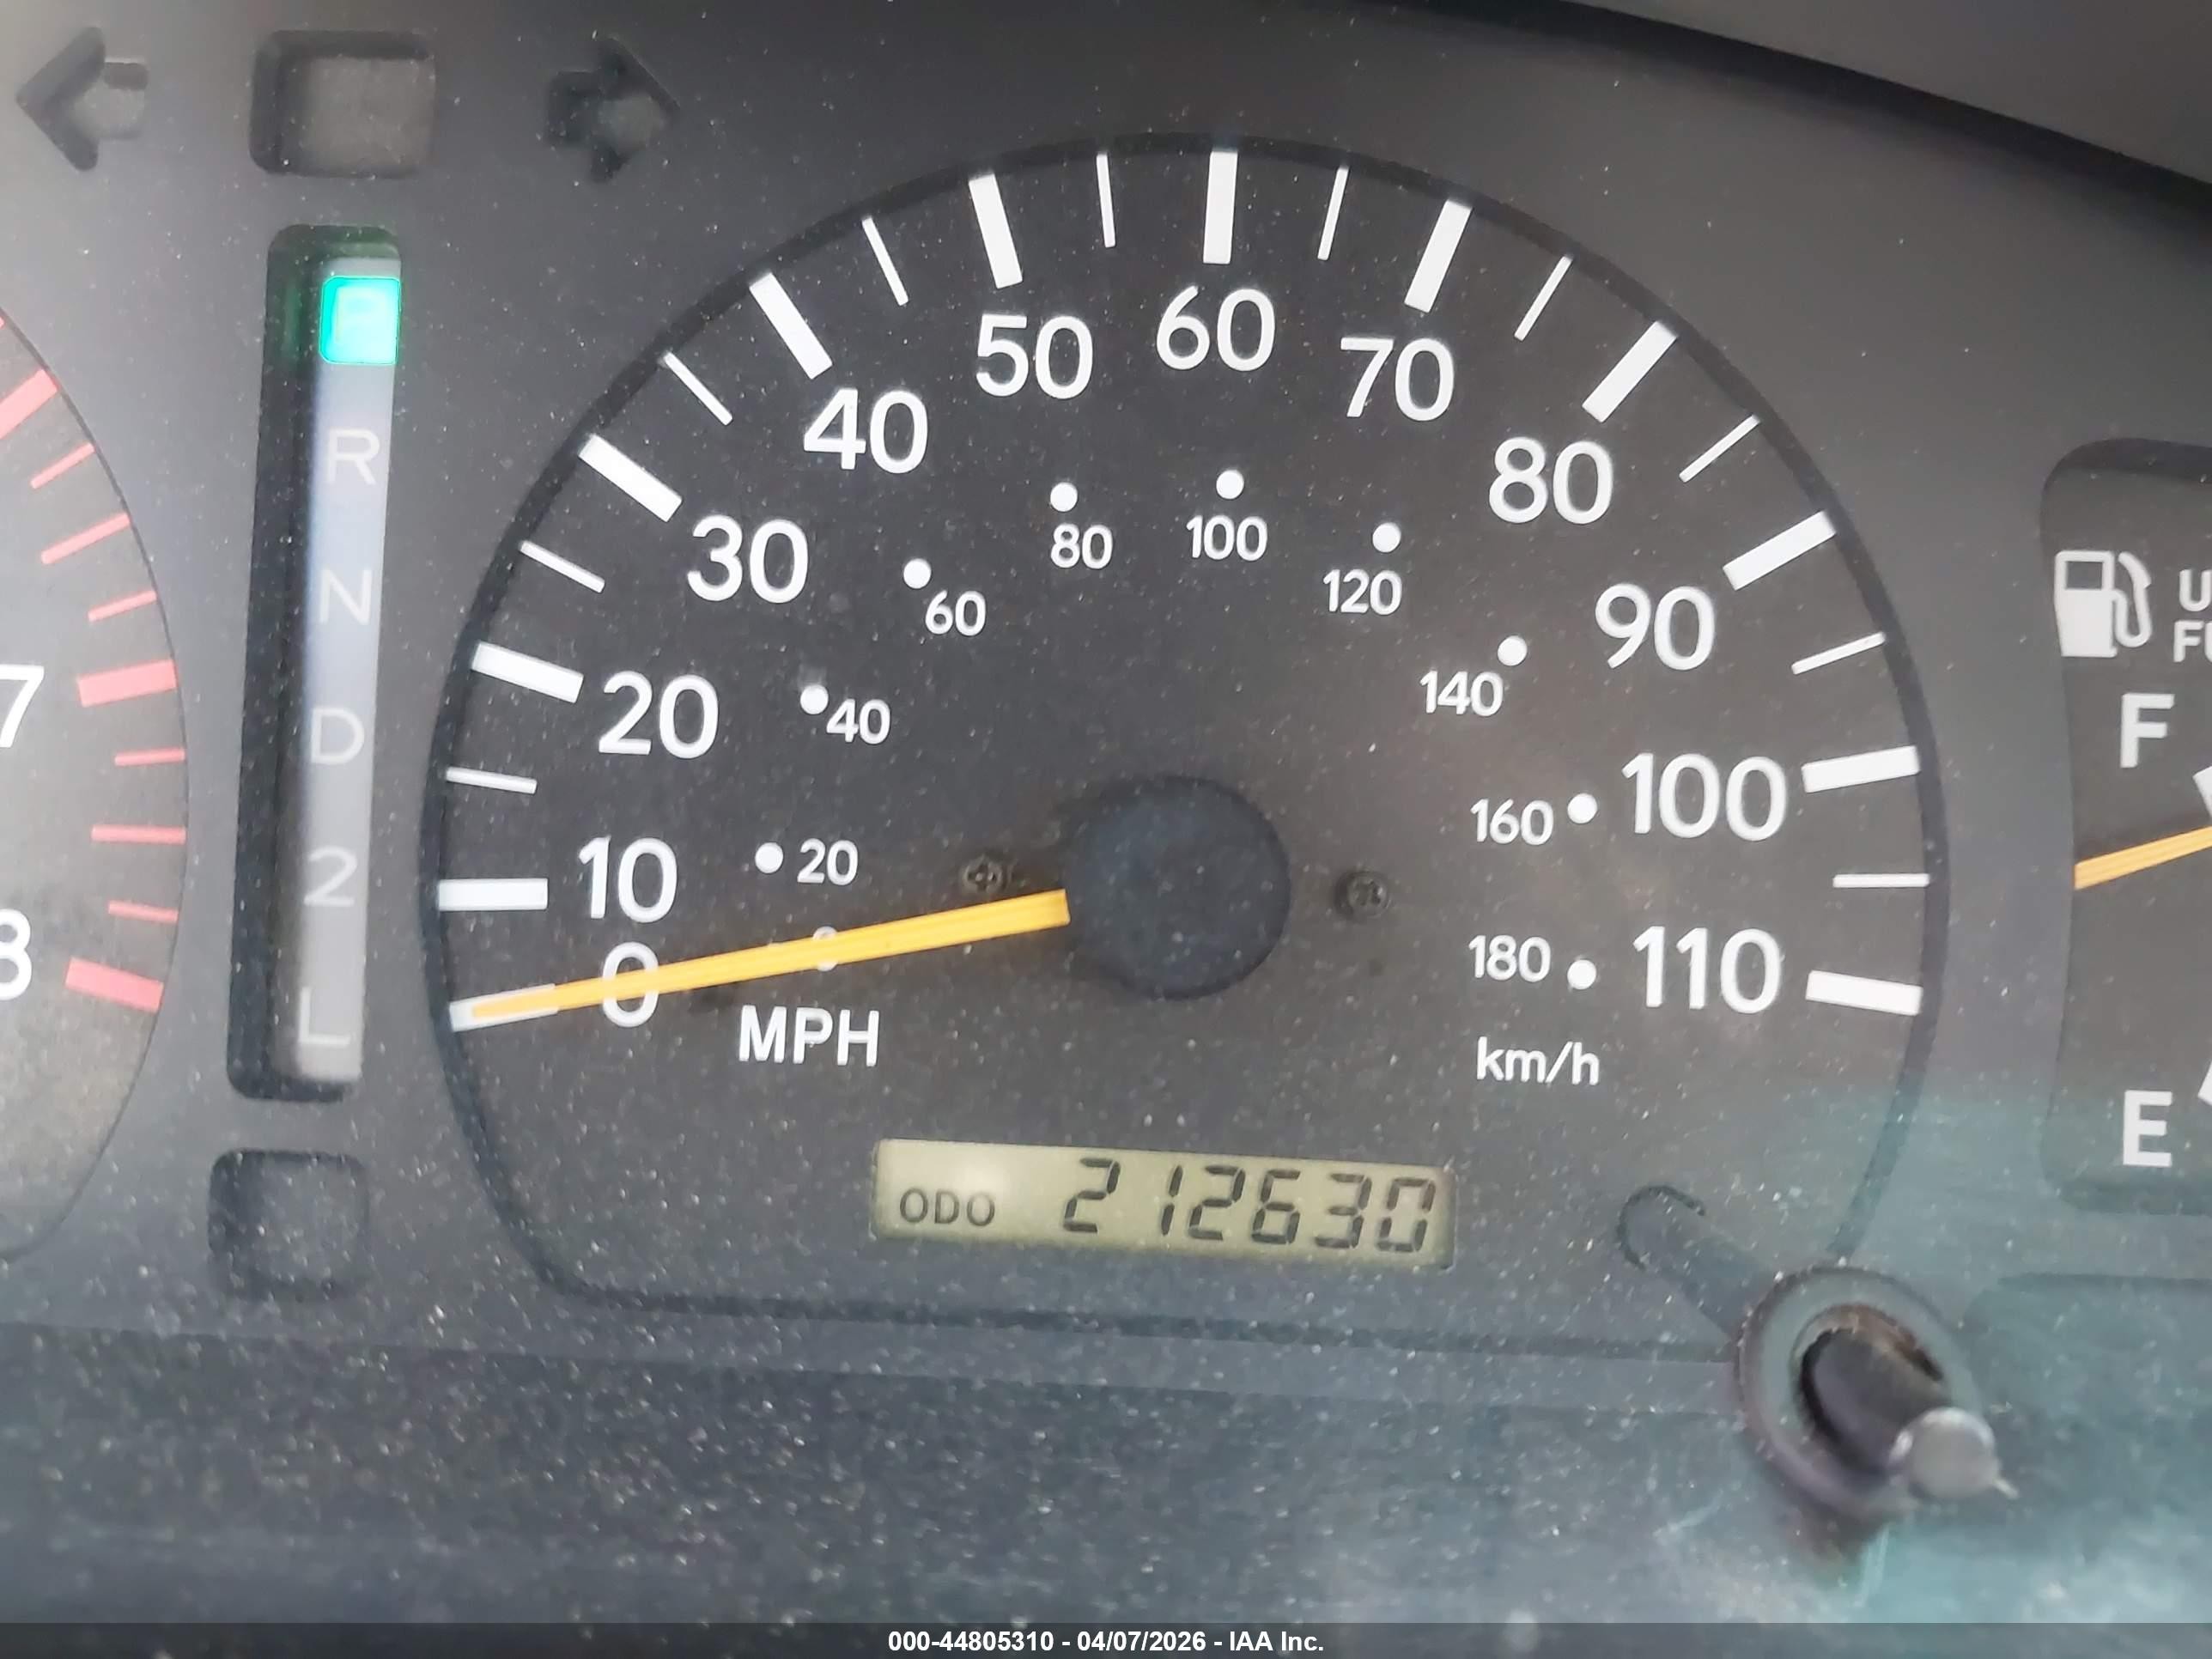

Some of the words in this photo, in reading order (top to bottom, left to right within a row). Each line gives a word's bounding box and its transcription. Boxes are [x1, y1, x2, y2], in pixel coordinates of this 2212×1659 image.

[975, 314, 1093, 398] 50
[1157, 286, 1275, 371] 60
[1340, 337, 1455, 422] 70
[328, 428, 380, 485] R
[803, 388, 928, 474] 40
[1489, 437, 1613, 525] 80
[687, 515, 808, 604] 30
[1051, 523, 1113, 569] 80
[1187, 515, 1268, 562] 100
[319, 568, 373, 624] N
[925, 590, 987, 636] 60
[1323, 568, 1402, 615] 120
[1595, 583, 1715, 671] 90
[2172, 619, 2212, 663] F
[0, 664, 45, 748] 7
[599, 671, 719, 759] 20
[826, 698, 891, 745] 40
[1420, 670, 1504, 716] 140
[311, 707, 366, 764] D
[2120, 692, 2175, 769] F
[1470, 799, 1554, 845] 160
[1622, 753, 1787, 842] 100
[303, 846, 358, 907] 2
[578, 836, 678, 923] 10
[797, 838, 858, 885] 20
[602, 941, 659, 1028] 0
[1468, 934, 1551, 982] 180
[1633, 926, 1784, 1014] 110
[297, 986, 351, 1047] L
[739, 1004, 880, 1067] MPH
[1475, 1036, 1600, 1085] km/h
[2123, 1090, 2173, 1167] E
[898, 1187, 996, 1227] ODO
[1061, 1157, 1437, 1254] 212630
